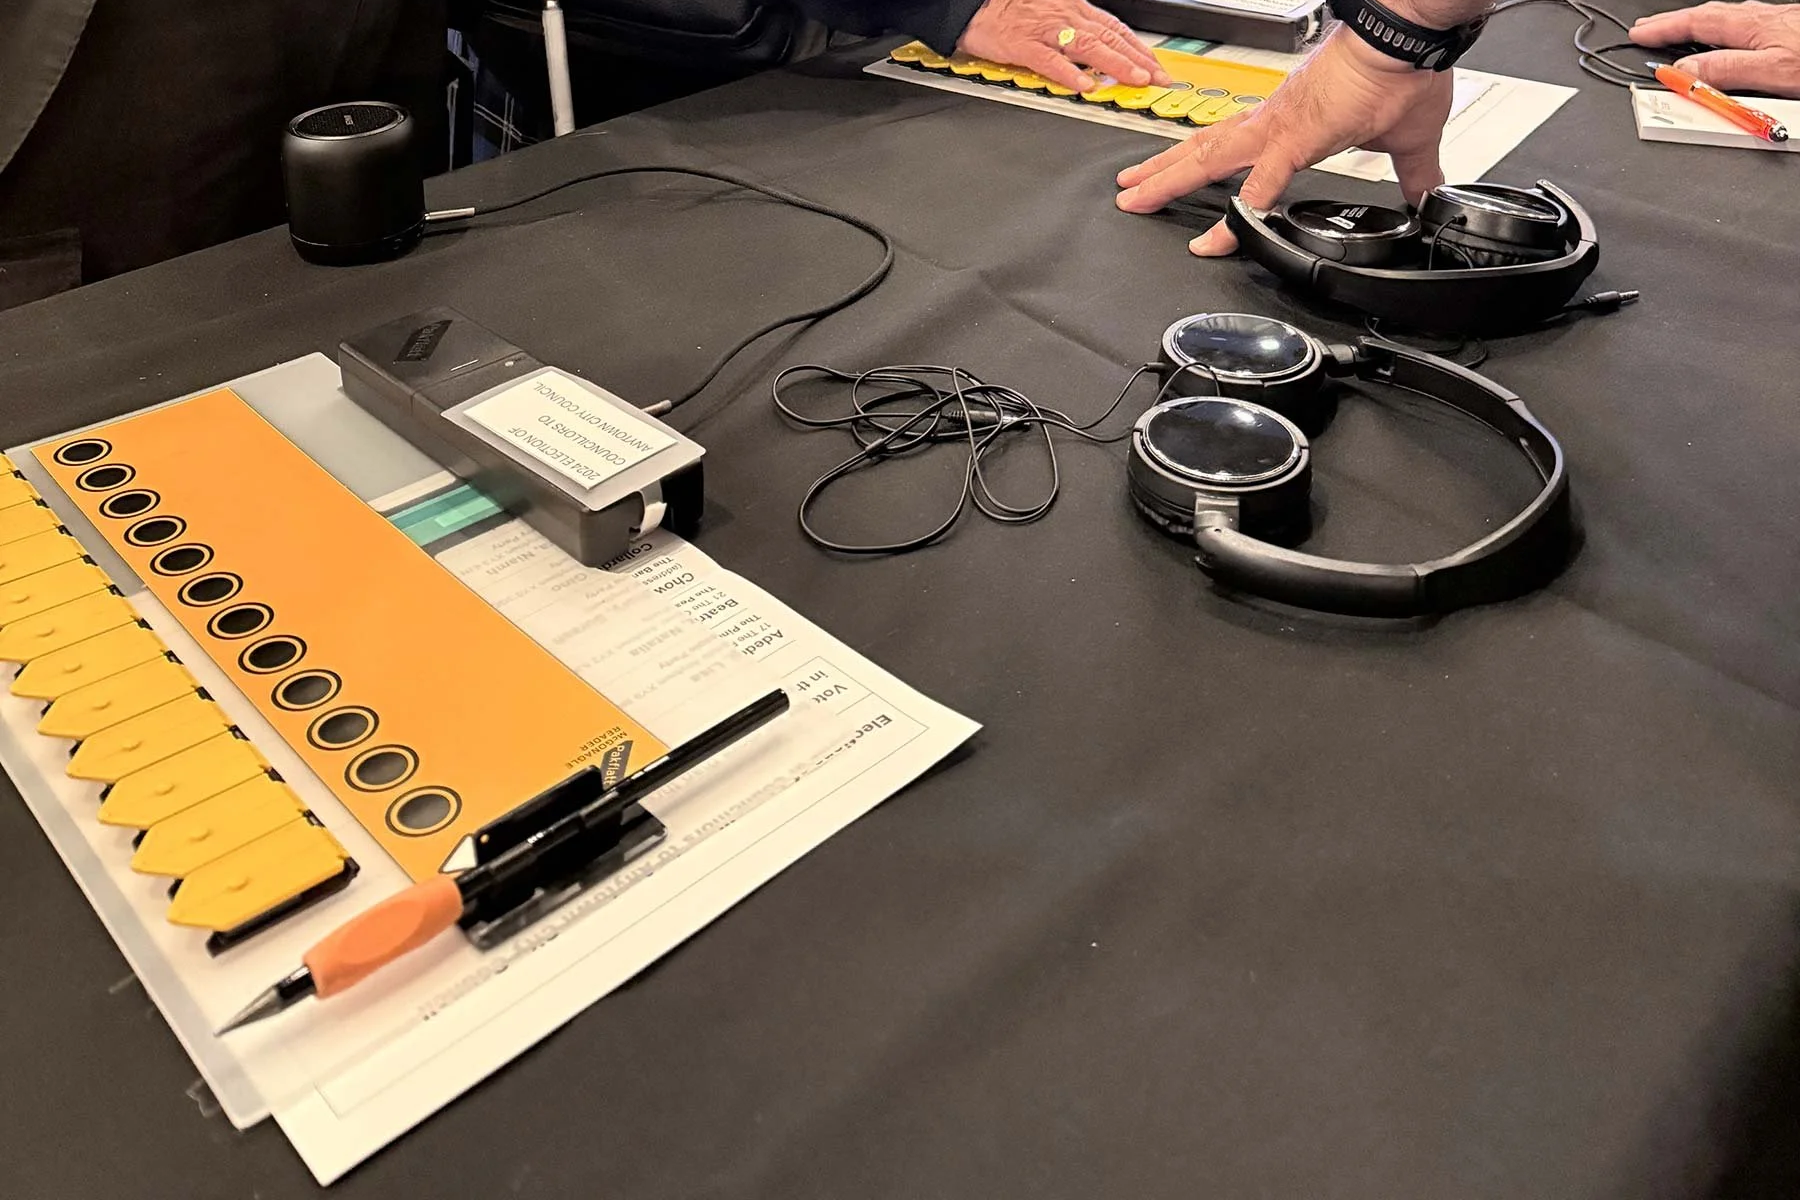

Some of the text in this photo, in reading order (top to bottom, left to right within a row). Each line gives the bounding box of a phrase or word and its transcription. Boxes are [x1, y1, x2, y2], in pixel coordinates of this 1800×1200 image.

[573, 408, 603, 425] CITY
[535, 413, 628, 466] COUNCILLORS TO
[596, 421, 654, 453] ANYTOWN
[505, 424, 602, 481] 2024 ELECTION OF
[650, 555, 673, 571] The
[692, 583, 716, 600] The
[690, 596, 713, 613] The
[735, 620, 771, 644] 17 The
[737, 611, 761, 629] The
[808, 668, 828, 684] in
[564, 730, 628, 770] McGONAGLE
[579, 724, 621, 752] READER
[602, 744, 625, 786] Pakflatt
